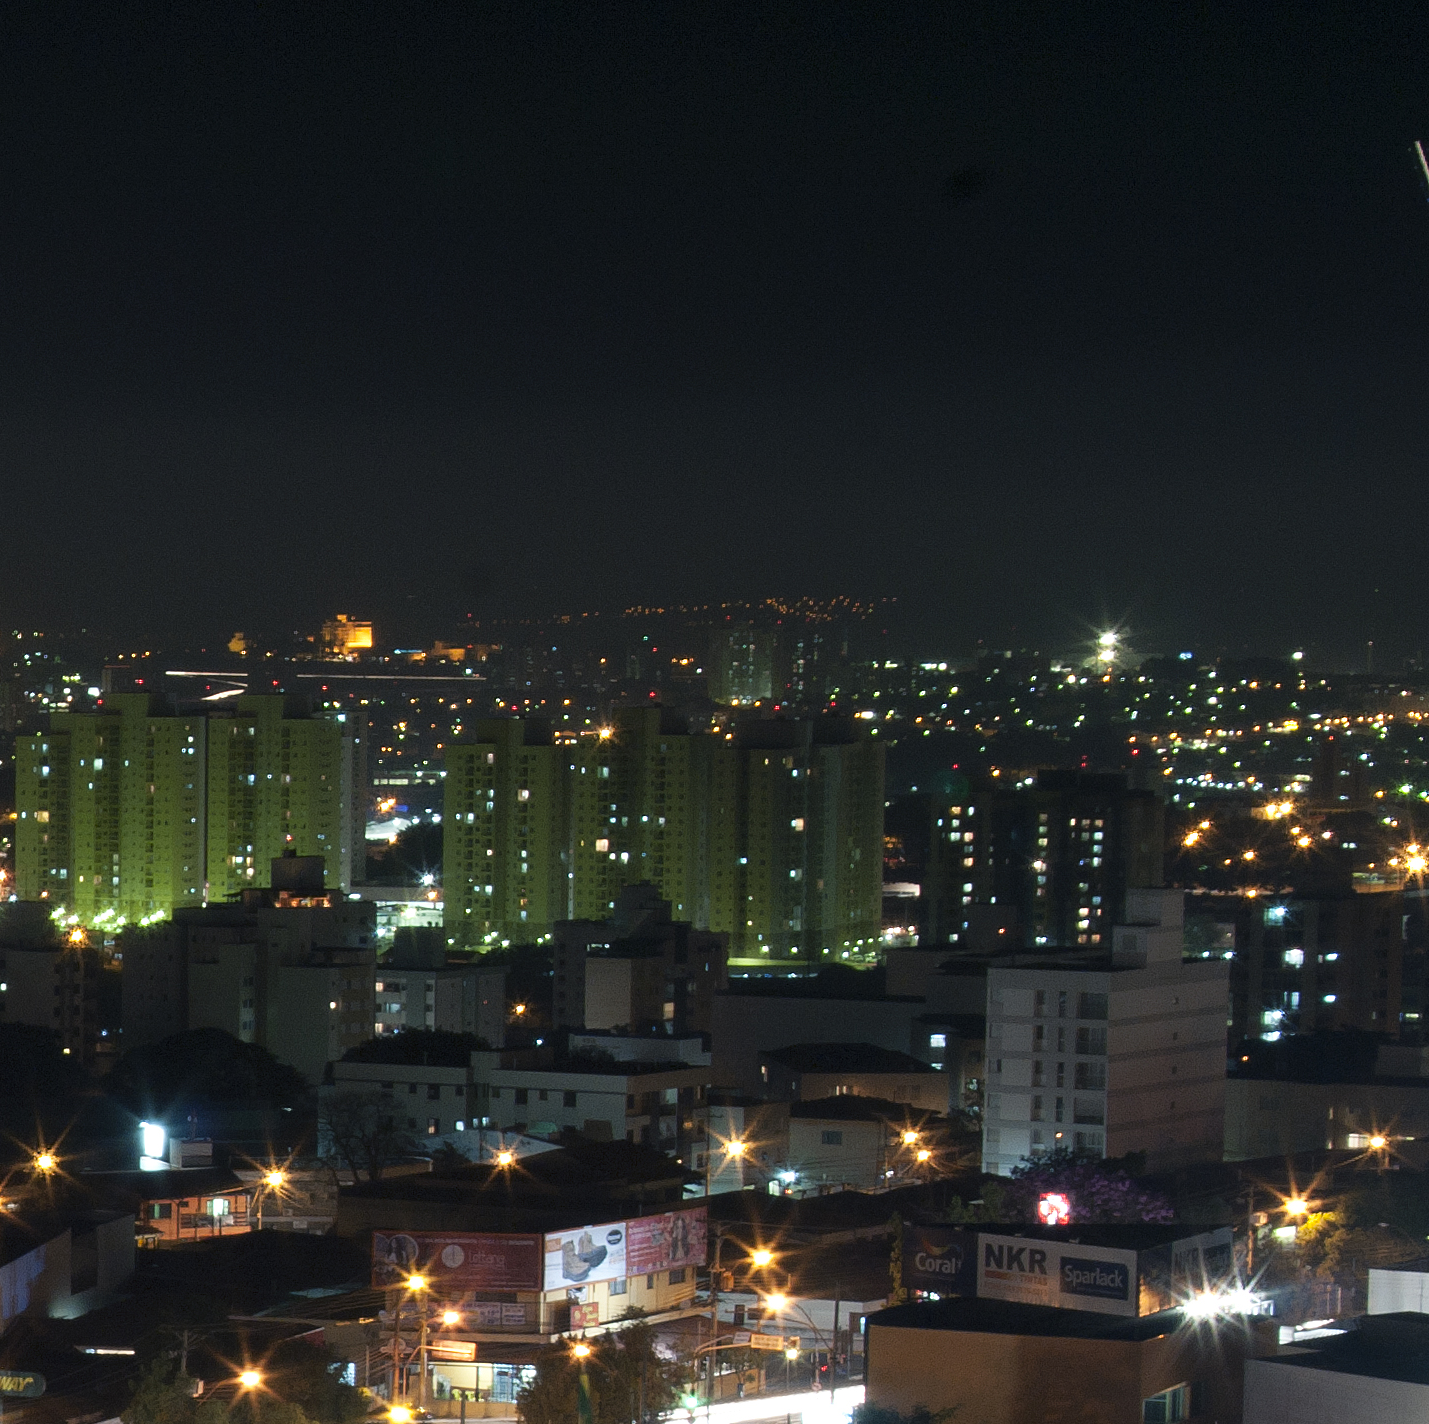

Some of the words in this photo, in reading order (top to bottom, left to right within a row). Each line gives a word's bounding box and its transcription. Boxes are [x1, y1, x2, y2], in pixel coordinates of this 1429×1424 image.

[915, 1252, 955, 1274] Coral
[984, 1242, 1048, 1275] NKR
[1064, 1265, 1123, 1288] Sparlack
